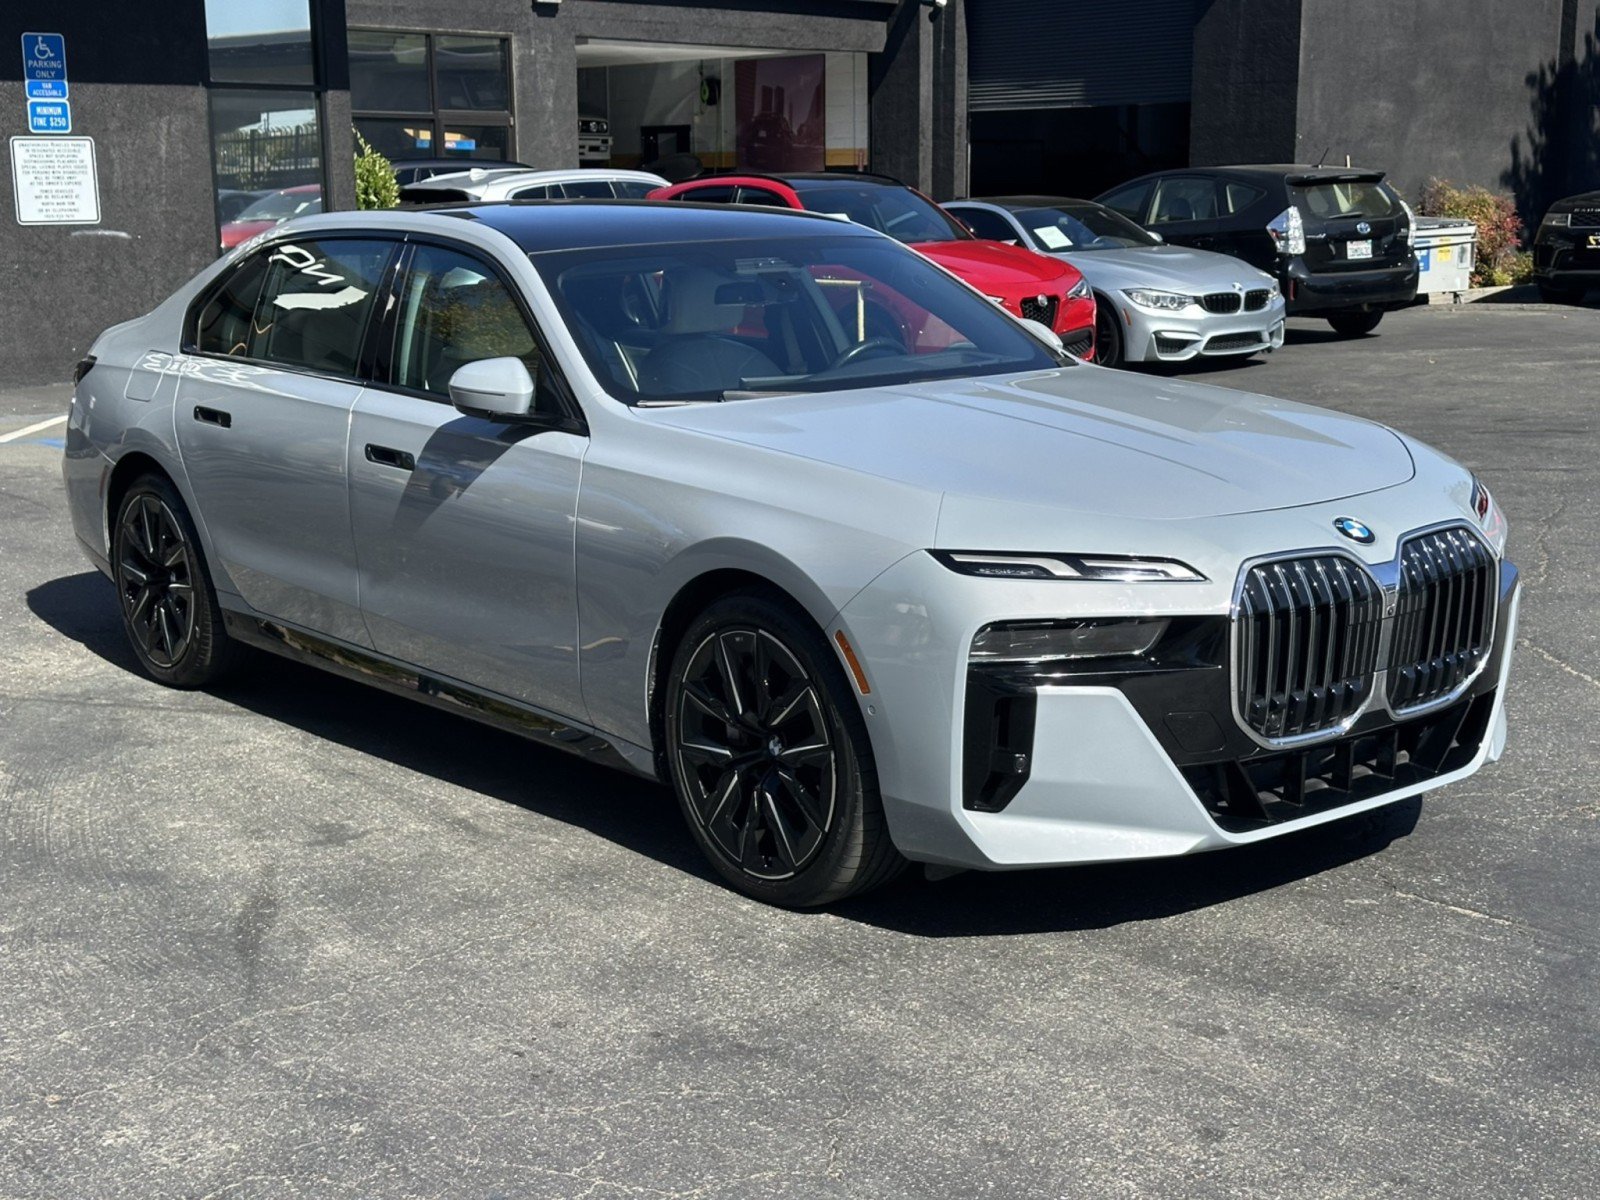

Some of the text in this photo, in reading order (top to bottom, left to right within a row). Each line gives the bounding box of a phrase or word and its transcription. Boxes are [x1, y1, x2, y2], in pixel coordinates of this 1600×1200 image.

[28, 60, 62, 68] PARKING
[36, 70, 56, 78] ONLY
[36, 106, 62, 115] MINIMUM
[33, 117, 67, 127] FINE $250
